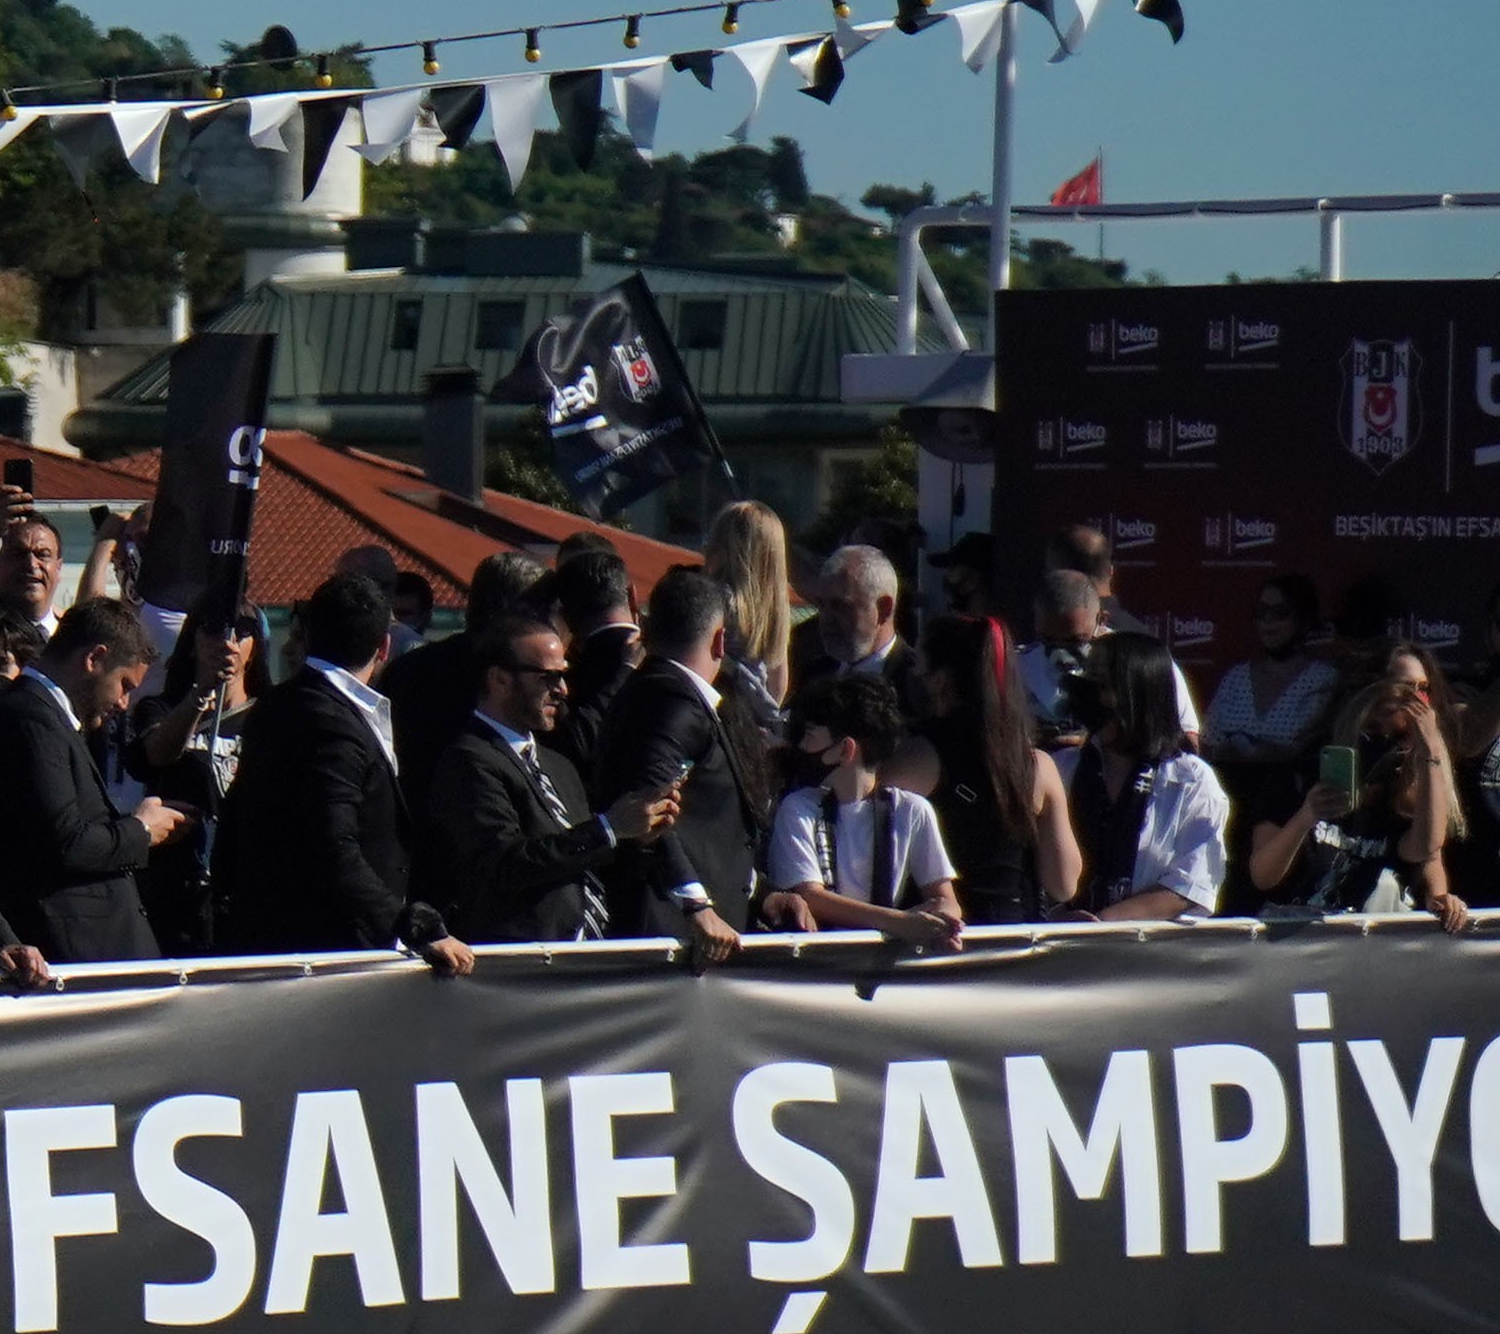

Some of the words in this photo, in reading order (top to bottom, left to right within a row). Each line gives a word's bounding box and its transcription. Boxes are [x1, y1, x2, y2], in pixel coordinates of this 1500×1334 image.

[1119, 323, 1159, 344] beko
[1238, 321, 1280, 342] beko
[1067, 421, 1106, 441] beko
[1177, 419, 1217, 441] beko
[1116, 518, 1156, 538] beko
[1235, 518, 1276, 538] beko
